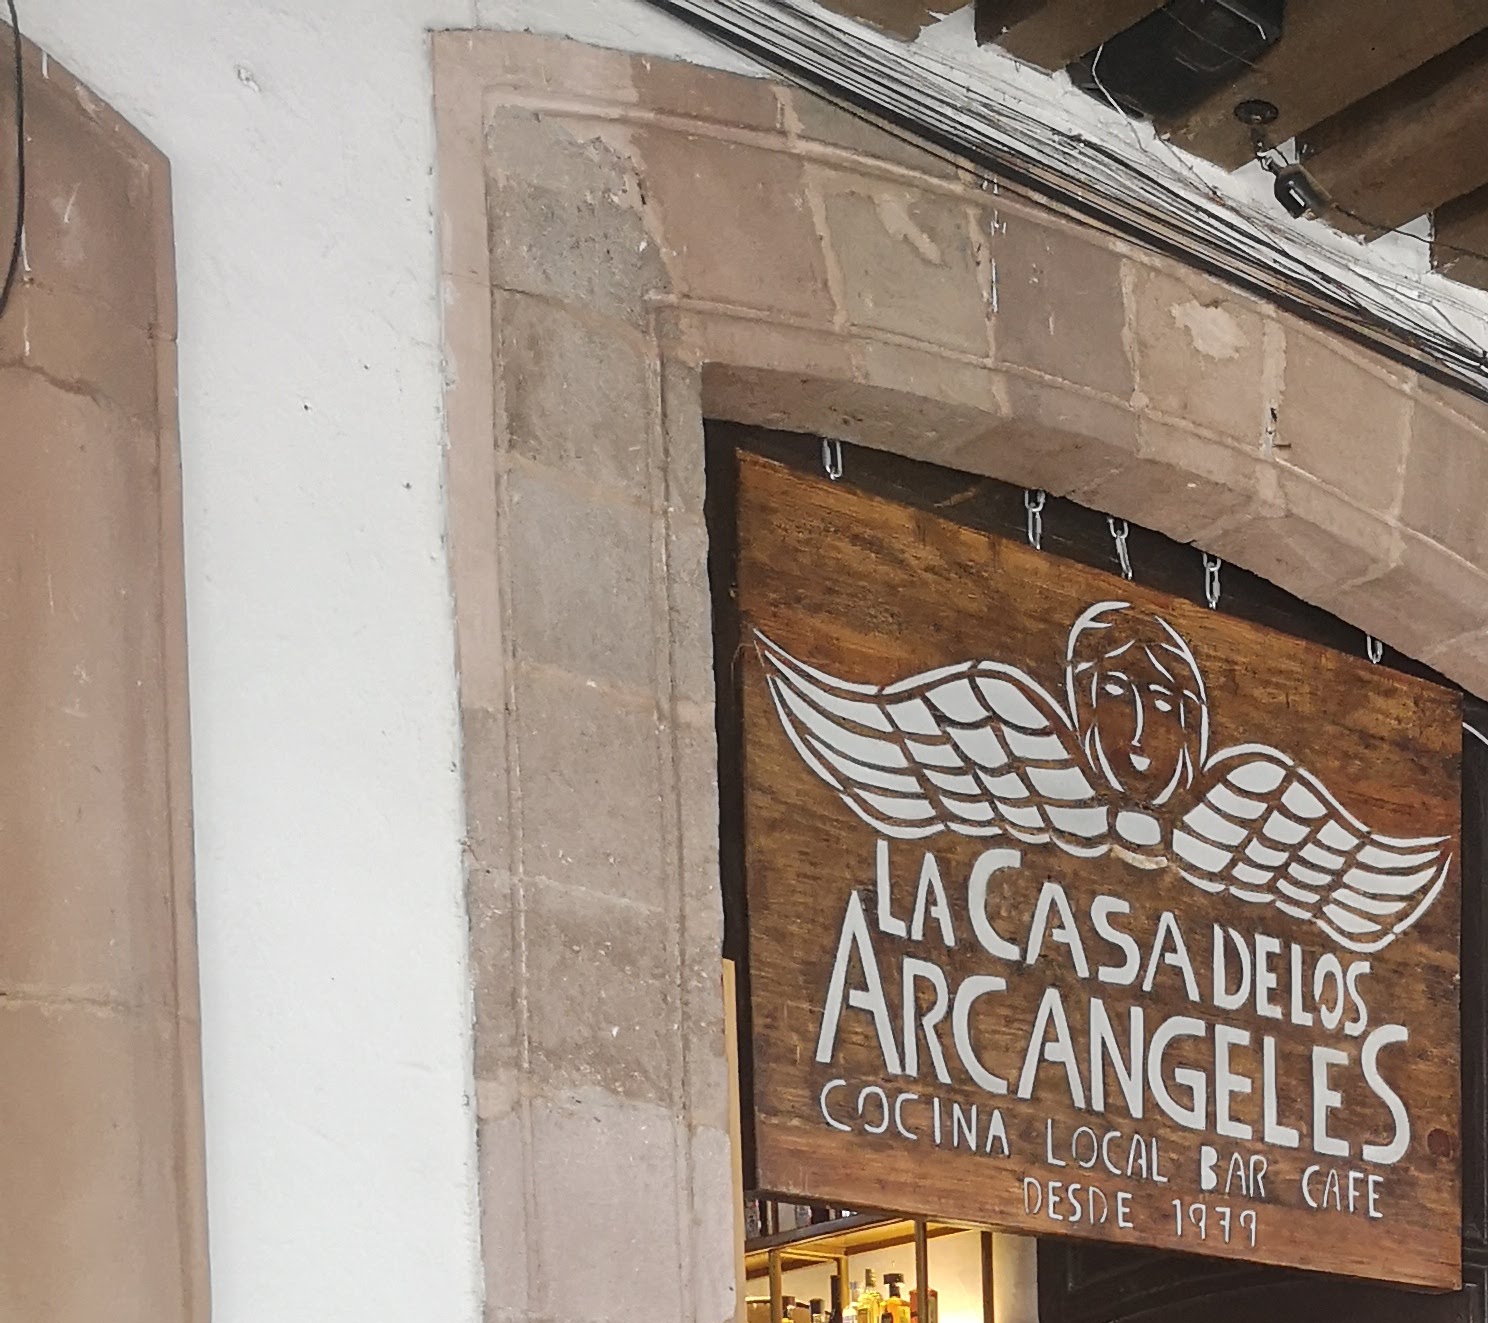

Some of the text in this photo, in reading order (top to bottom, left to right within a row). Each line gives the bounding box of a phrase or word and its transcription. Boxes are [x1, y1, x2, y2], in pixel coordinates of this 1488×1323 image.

[876, 839, 1371, 1036] LA CASA DE LOS
[815, 889, 1411, 1165] ARCANGELES
[818, 1078, 1384, 1219] COCINA LOCAL BAR CAFE
[1022, 1176, 1257, 1247] DESDE 1979
